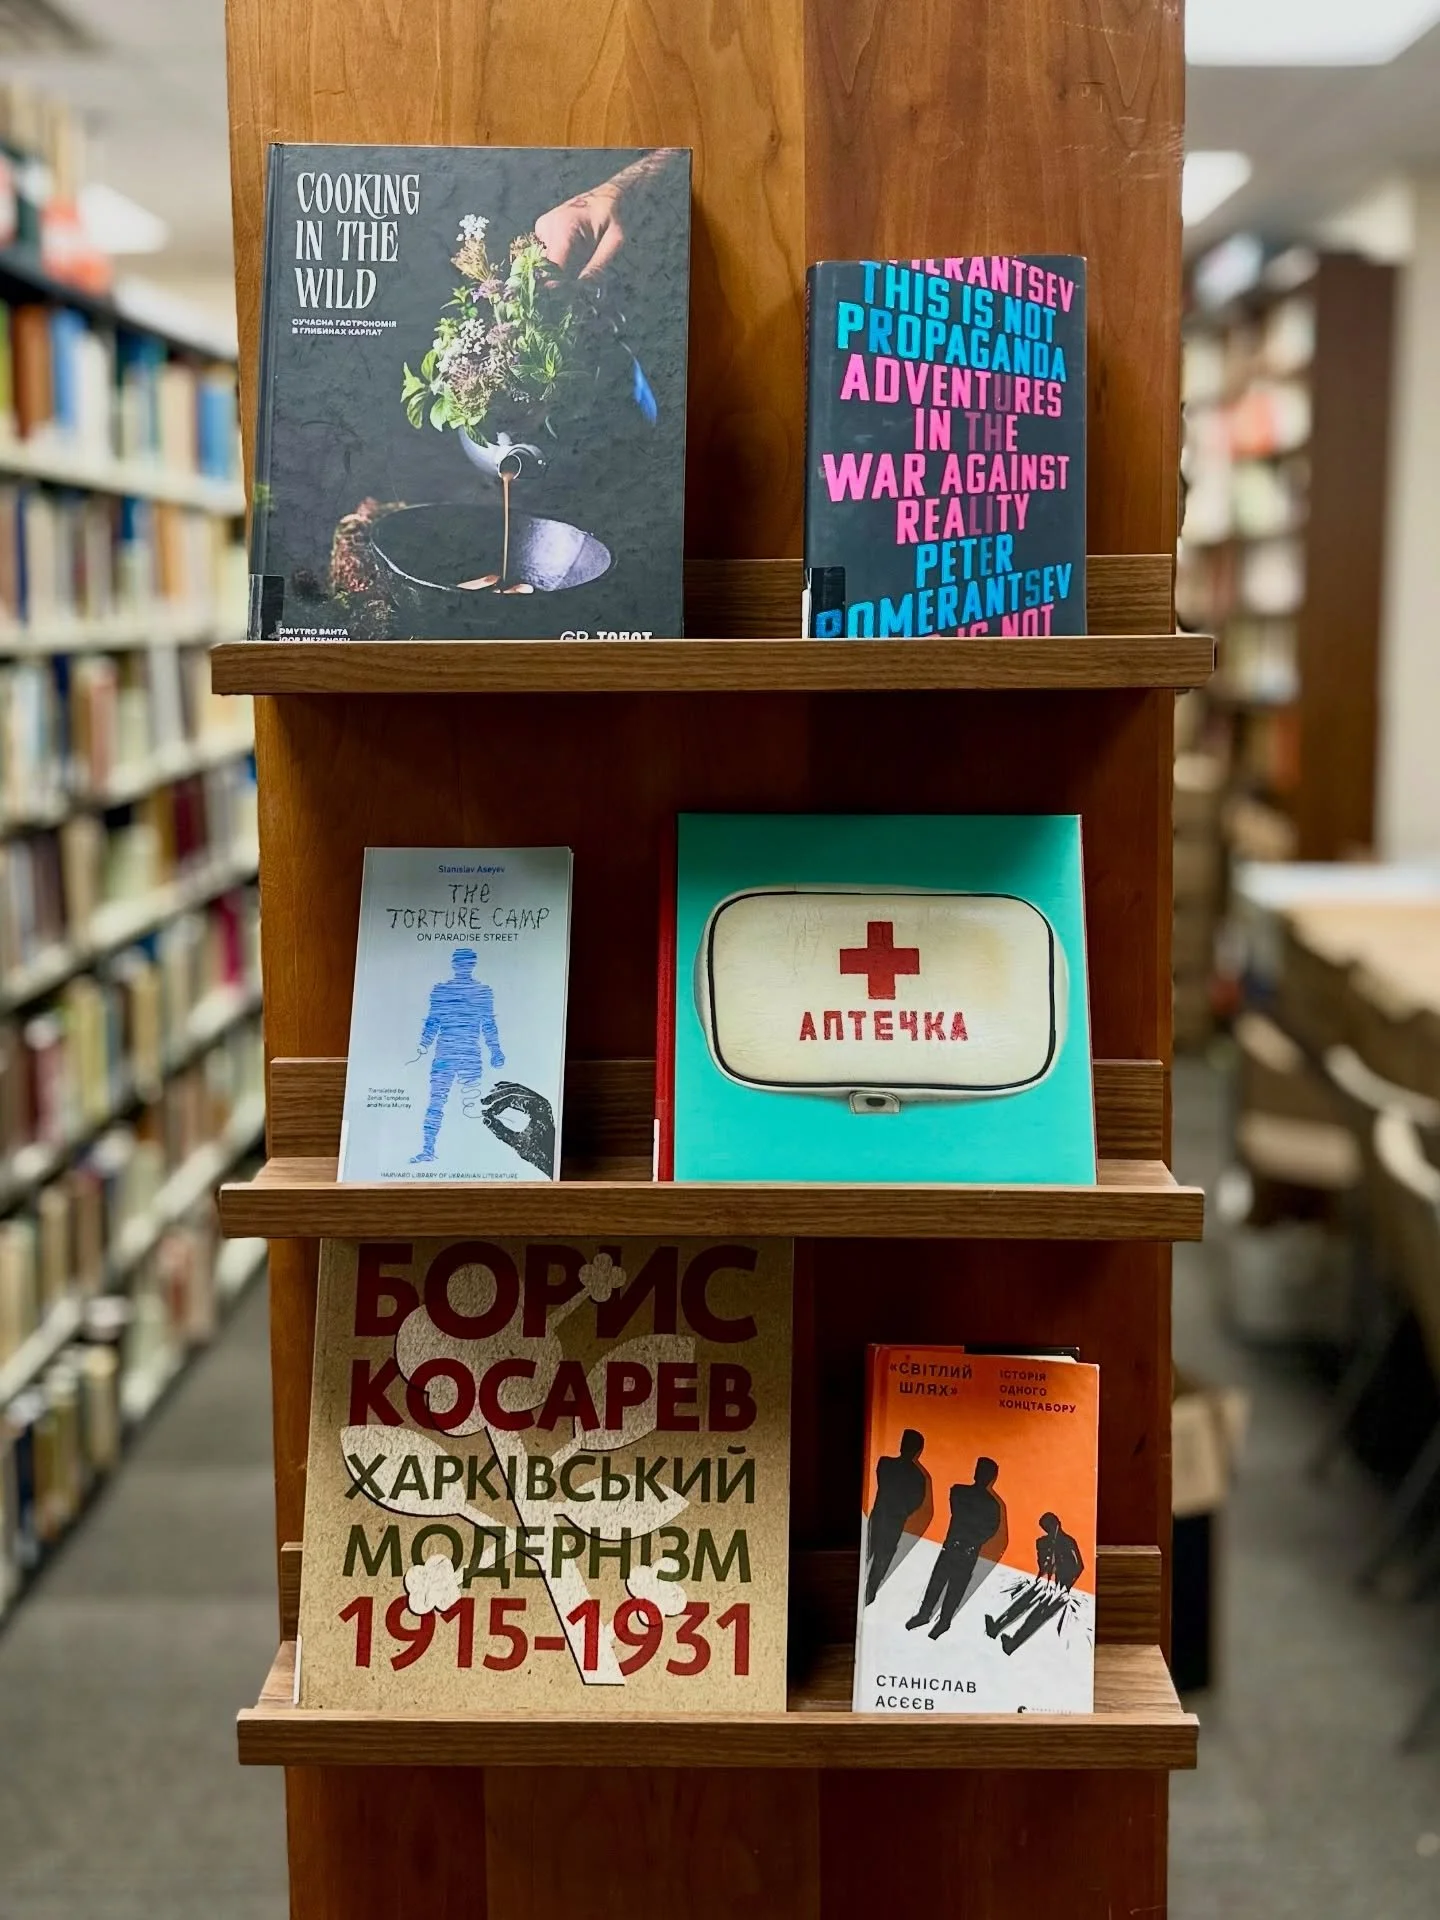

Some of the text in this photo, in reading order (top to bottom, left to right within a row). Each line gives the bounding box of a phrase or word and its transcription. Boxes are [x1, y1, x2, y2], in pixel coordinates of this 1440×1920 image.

[297, 172, 420, 219] COOKING
[295, 219, 399, 262] IN THE
[294, 267, 377, 309] WILD
[860, 261, 1057, 343] THIS IS NOT
[292, 318, 397, 328] СУЧАСНА ГАСТРОНОМІЯ
[299, 327, 347, 335] ГЛИБИНАХ
[348, 328, 383, 336] КАРПАТ
[837, 301, 1067, 382] PROPAGANDA
[840, 353, 1062, 418] ADVENTURES
[914, 409, 1018, 452] IN THE
[823, 453, 1070, 502] WAR AGAINST
[896, 493, 1030, 545] REALITY
[916, 533, 1014, 589] PETER
[815, 563, 1072, 639] POMERANTSEV
[280, 627, 348, 636] DMYTRO BAHTA
[438, 865, 505, 876] Stanislav Aseyev
[386, 907, 551, 930] TORTURE CAMP
[417, 933, 519, 942] ON PARADISE STREET
[799, 1010, 969, 1041] АПТЕЧКА
[354, 1241, 758, 1344] БОРИС
[348, 1357, 757, 1432] КОСАРЕВ
[1000, 1370, 1046, 1382] ІСТОРІЯ
[1000, 1385, 1047, 1397] ОДНОГО
[999, 1399, 1077, 1414] КОНЦТАБОРУ
[344, 1446, 756, 1504] ХАРКІВСЬКИЙ
[342, 1524, 752, 1589] МОДЕРНІЗМ
[875, 1695, 934, 1711] АСЄЄВ
[876, 1674, 977, 1694] СТАНІСЛАВ
